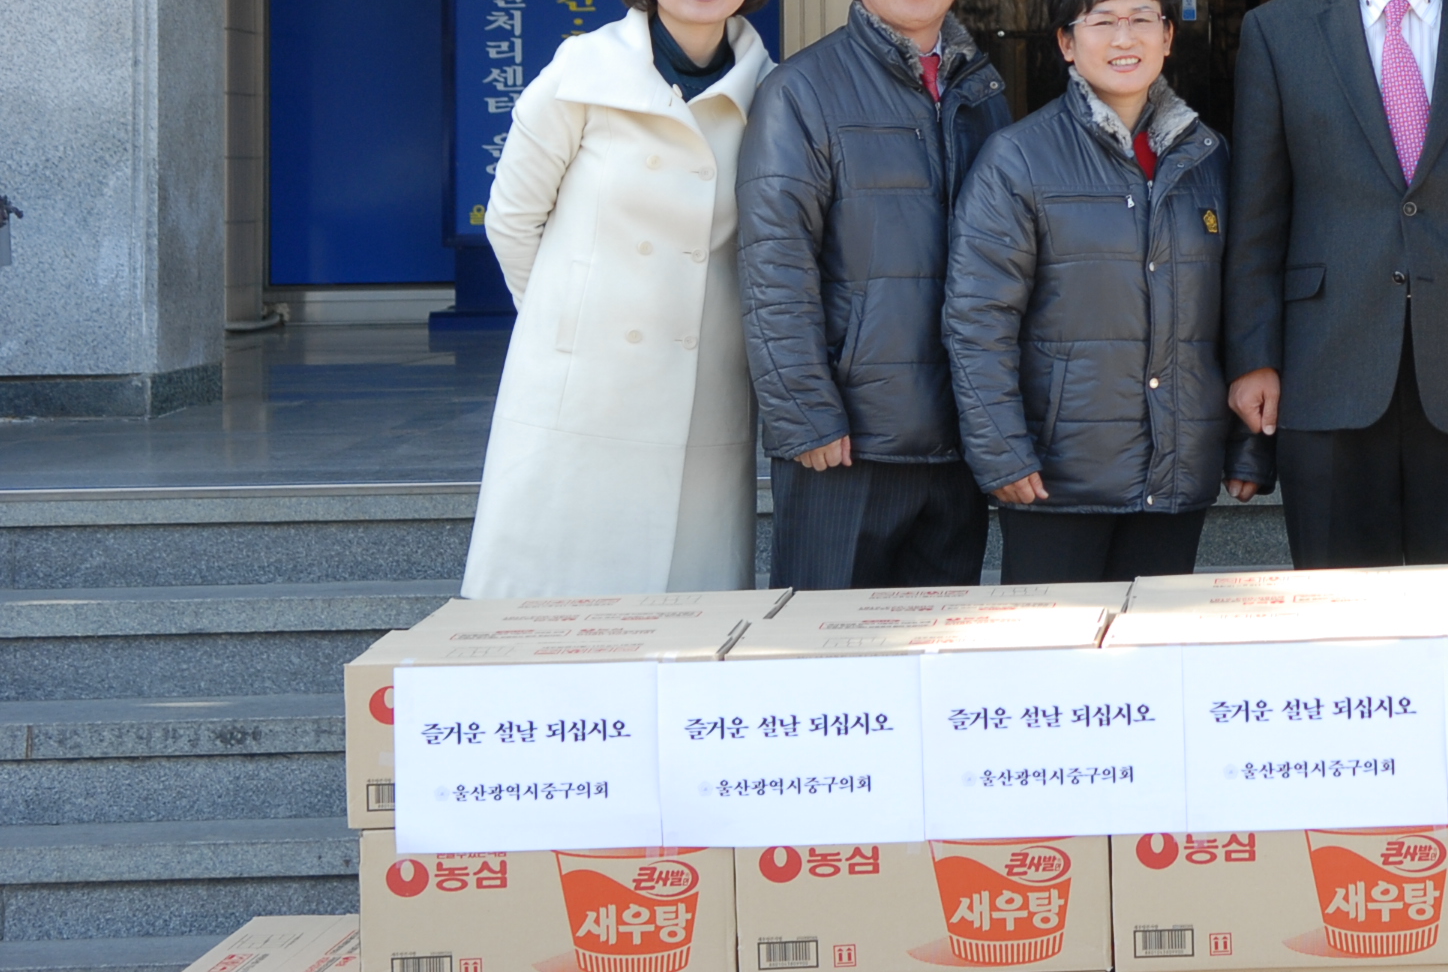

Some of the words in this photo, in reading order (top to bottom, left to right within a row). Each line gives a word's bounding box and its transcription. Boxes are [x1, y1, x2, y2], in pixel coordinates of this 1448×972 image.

[946, 706, 1014, 731] 즐거운
[1020, 704, 1061, 729] 설날
[1071, 702, 1156, 729] 되십시오
[1210, 699, 1273, 724] 즐거운
[1281, 697, 1323, 722] 설날
[1333, 695, 1417, 721] 되십시오
[421, 721, 486, 746] 즐거운
[494, 719, 538, 744] 설날
[546, 718, 632, 744] 되십시오
[684, 715, 749, 741] 즐거운
[757, 714, 799, 739] 설날
[809, 711, 894, 738] 되십시오
[980, 765, 1135, 788] 울산광역시중구의회
[1242, 757, 1396, 780] 울산광역시중구의회
[453, 780, 609, 803] 울산광역시중구의회
[716, 774, 872, 798] 울산광역시중구의회
[807, 845, 880, 878] 농심
[1183, 832, 1257, 865] 농심
[434, 860, 508, 892] 농심
[949, 888, 1066, 932] 새우탕
[1325, 879, 1441, 923] 새우탕
[576, 902, 693, 946] 새우탕
